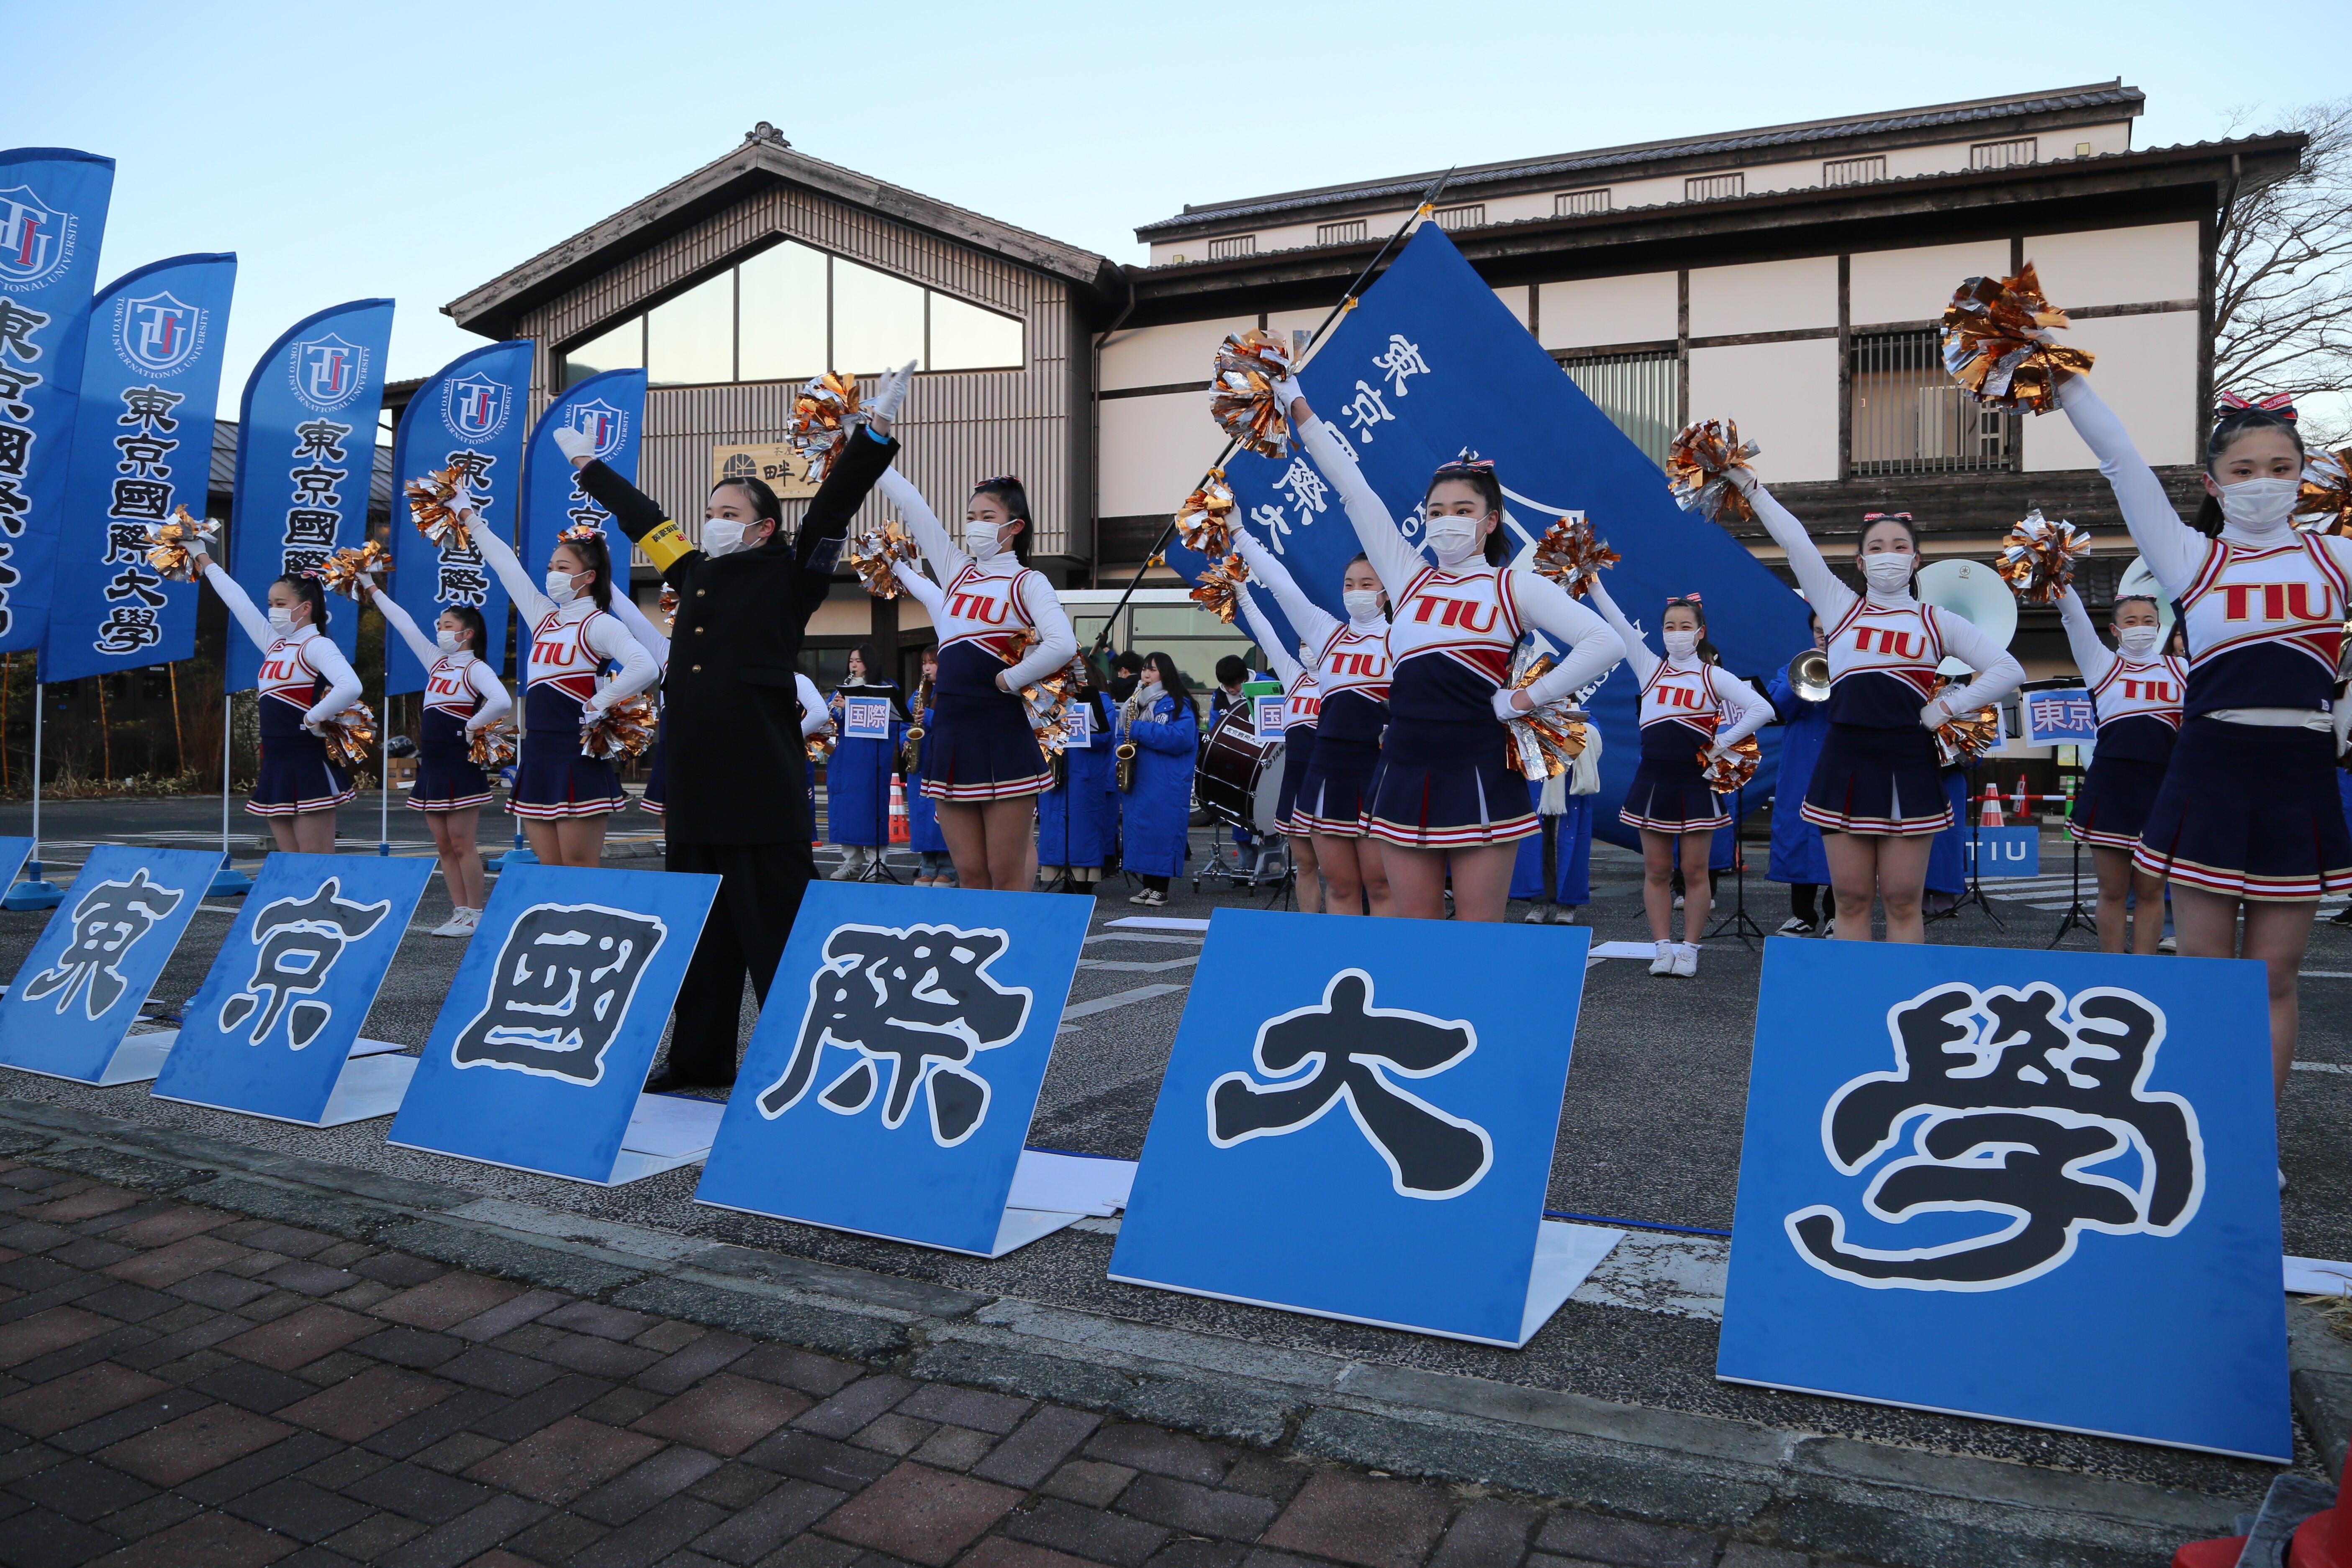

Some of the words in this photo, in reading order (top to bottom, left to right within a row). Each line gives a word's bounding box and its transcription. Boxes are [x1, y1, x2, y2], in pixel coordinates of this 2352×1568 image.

[47, 213, 79, 283] UNIVERSITY
[113, 297, 125, 331] TOKYO
[112, 334, 185, 379] INTERNATIONAL
[183, 308, 209, 368] UNIVERSITY
[289, 341, 299, 373] TOKYO
[349, 346, 370, 401] UNIVERSITY
[441, 377, 451, 406] TOKYO
[288, 375, 351, 413] INTERNATIONAL
[494, 385, 513, 435] UNIVERSITY
[441, 408, 495, 445] INTERNATIONAL
[613, 410, 629, 456] UNIVERSITY
[92, 384, 185, 654] 東京國際大學
[950, 593, 1010, 626] TIU
[1413, 594, 1499, 635] TIU
[2211, 582, 2333, 623] TIU
[531, 641, 577, 667] TIU
[1852, 626, 1926, 661] TIU
[258, 660, 295, 681] TIU
[1330, 652, 1387, 679] TIU
[426, 676, 462, 696] TIU
[1656, 685, 1706, 711] TIU
[2118, 678, 2180, 704] TIU
[849, 704, 886, 729] 国際
[2030, 697, 2094, 731] 東京
[1965, 841, 2026, 861] TIU
[22, 867, 184, 1021] 東
[218, 875, 392, 1052] 京
[451, 902, 668, 1088] 國
[756, 922, 1033, 1148] 際
[1206, 967, 1494, 1201] 大
[1784, 981, 2206, 1293] 學
